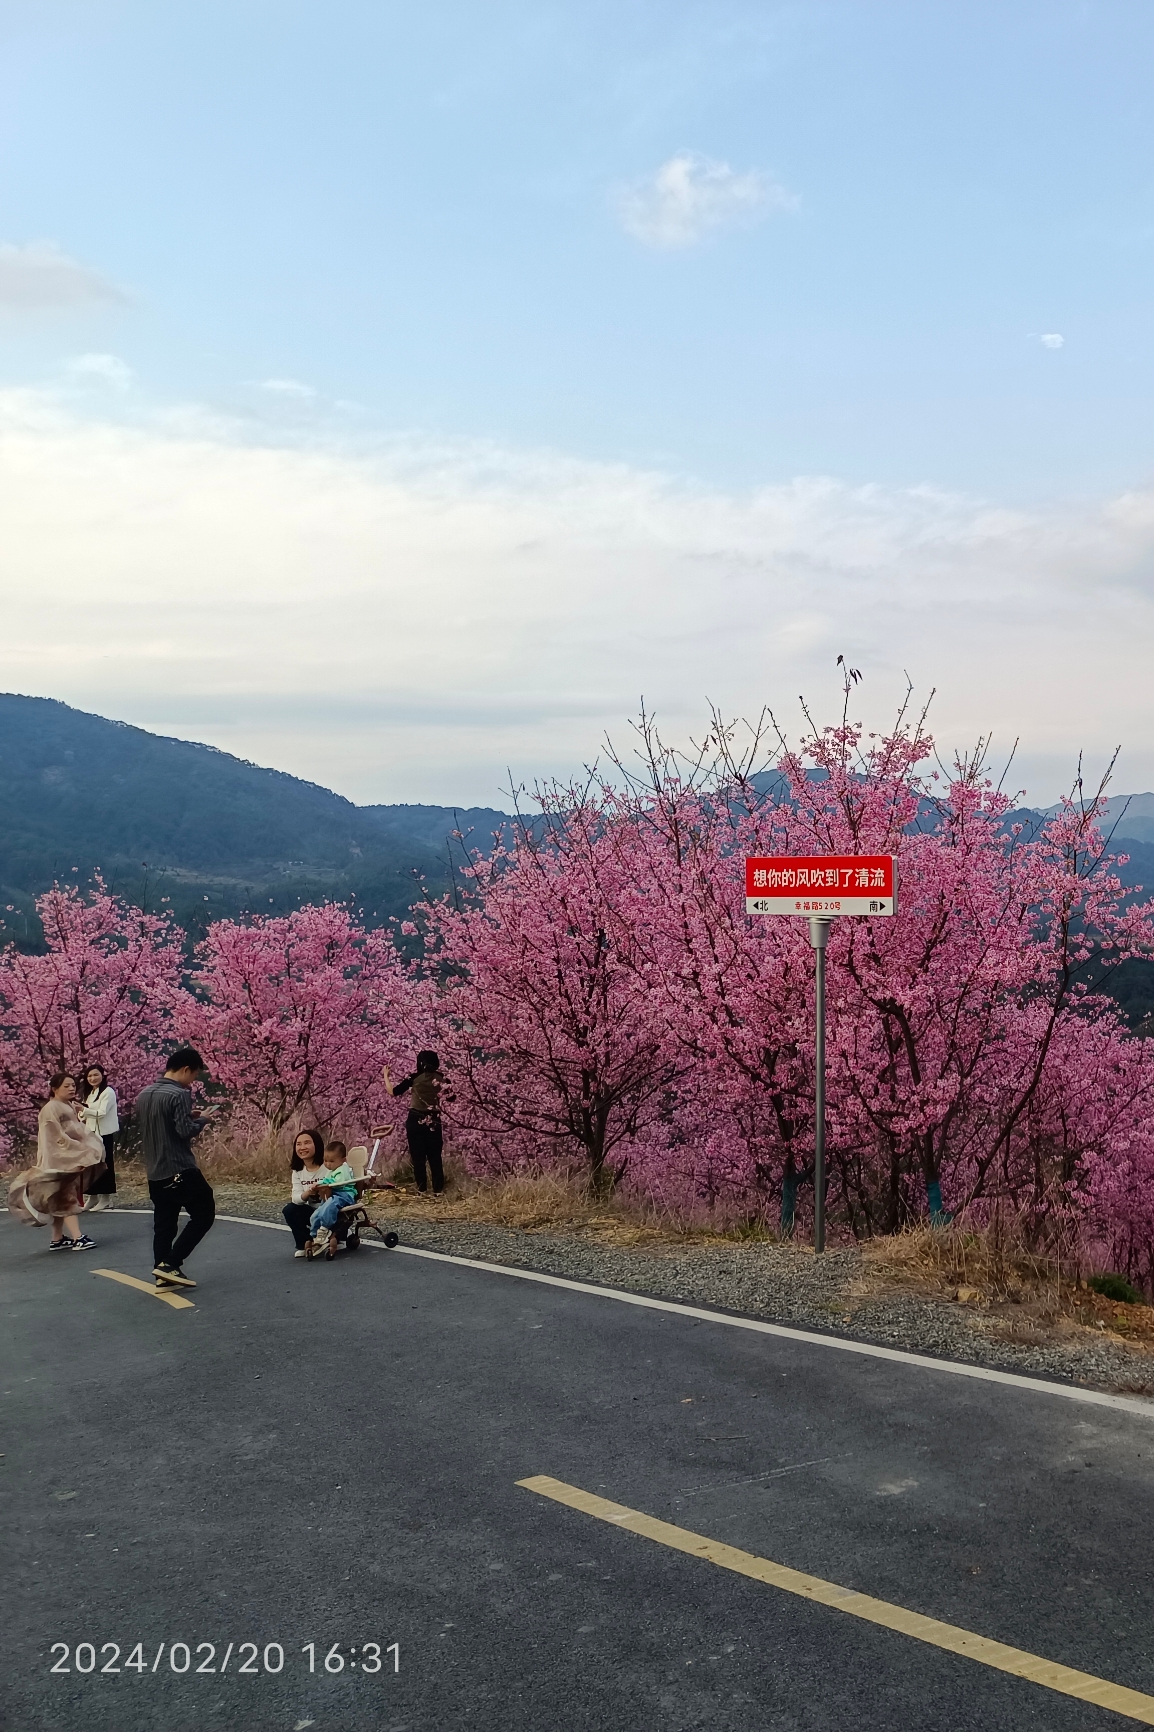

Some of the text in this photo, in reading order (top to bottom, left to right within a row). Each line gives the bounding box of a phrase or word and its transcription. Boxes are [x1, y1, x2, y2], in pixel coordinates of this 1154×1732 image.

[753, 868, 886, 888] 想你的风吹到了清流
[759, 900, 769, 912] 北
[869, 900, 878, 912] 南
